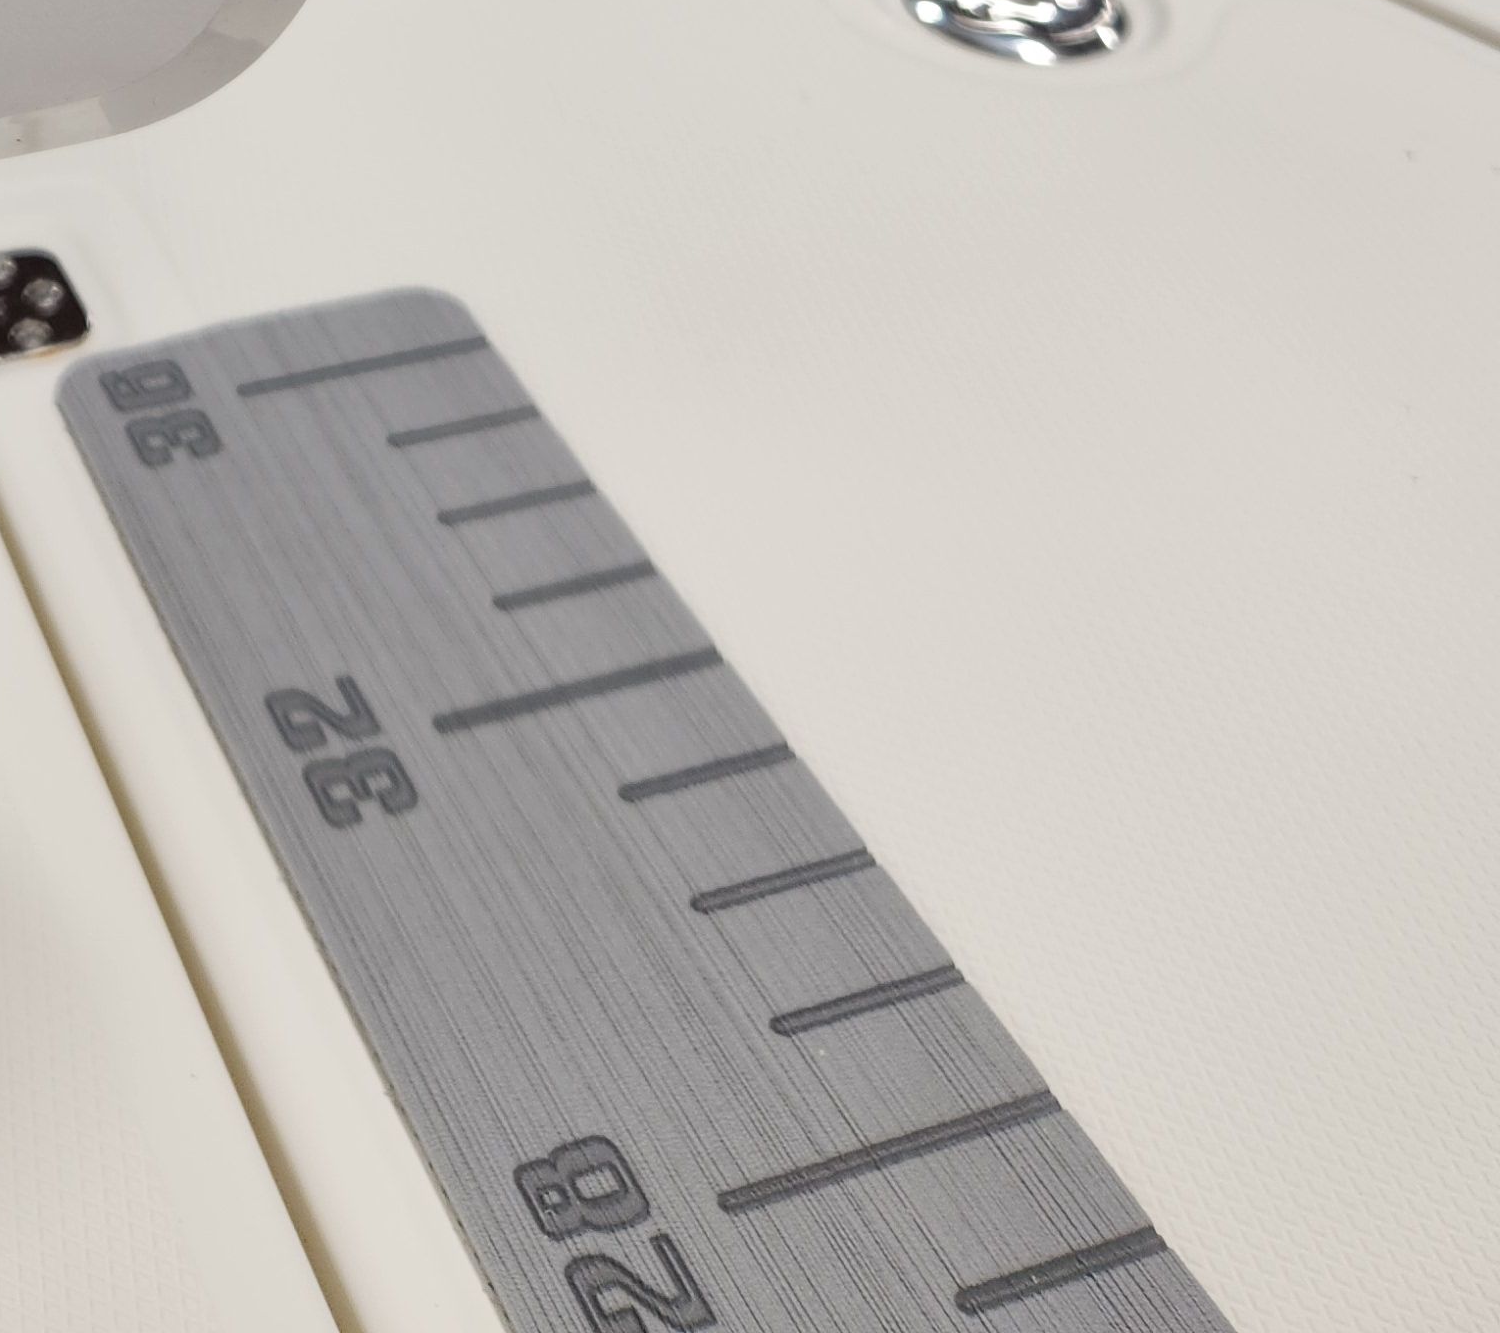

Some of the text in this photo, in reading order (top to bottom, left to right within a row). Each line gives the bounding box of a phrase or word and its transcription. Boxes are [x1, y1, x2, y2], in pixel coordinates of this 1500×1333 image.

[97, 358, 223, 468] 36
[263, 674, 419, 829] 32
[513, 1134, 718, 1333] 28
